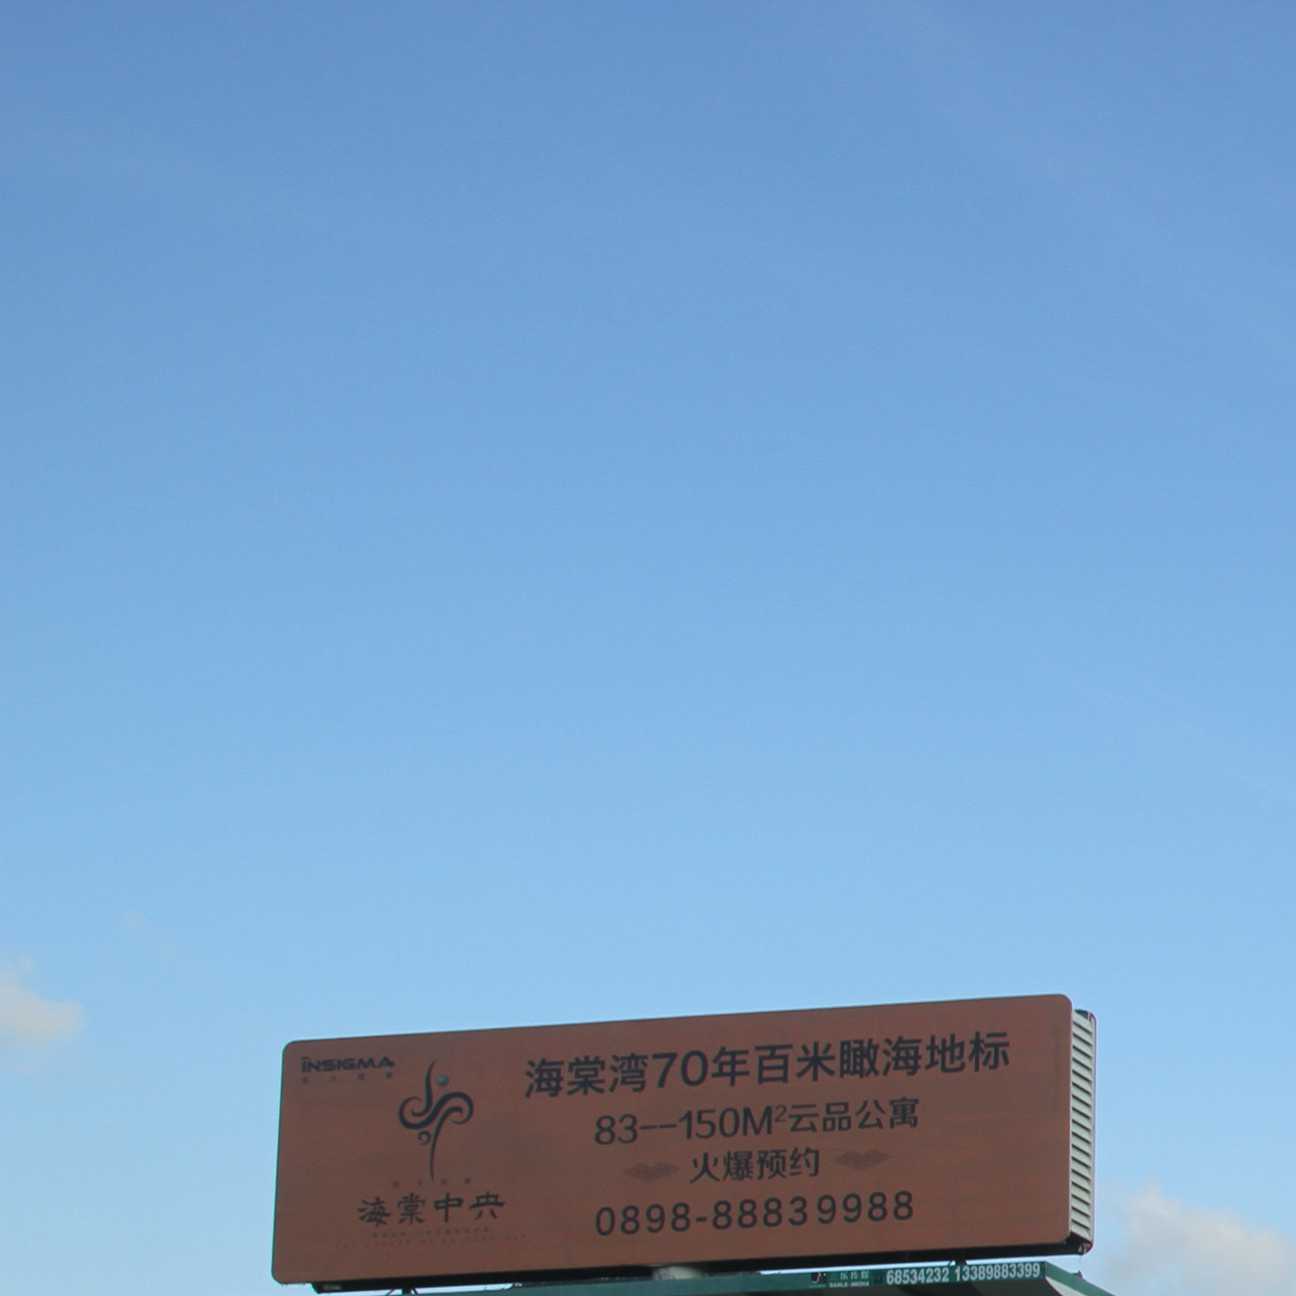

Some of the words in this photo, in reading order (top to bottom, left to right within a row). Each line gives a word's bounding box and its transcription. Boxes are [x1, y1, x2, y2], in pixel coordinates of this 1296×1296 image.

[525, 1031, 1010, 1099] 海棠湾70年百米瞰海地标
[690, 1147, 820, 1184] 火爆预约
[596, 1190, 914, 1237] 0898-88839988
[886, 1267, 949, 1286] 68534232
[954, 1262, 1041, 1283] 13389883399
